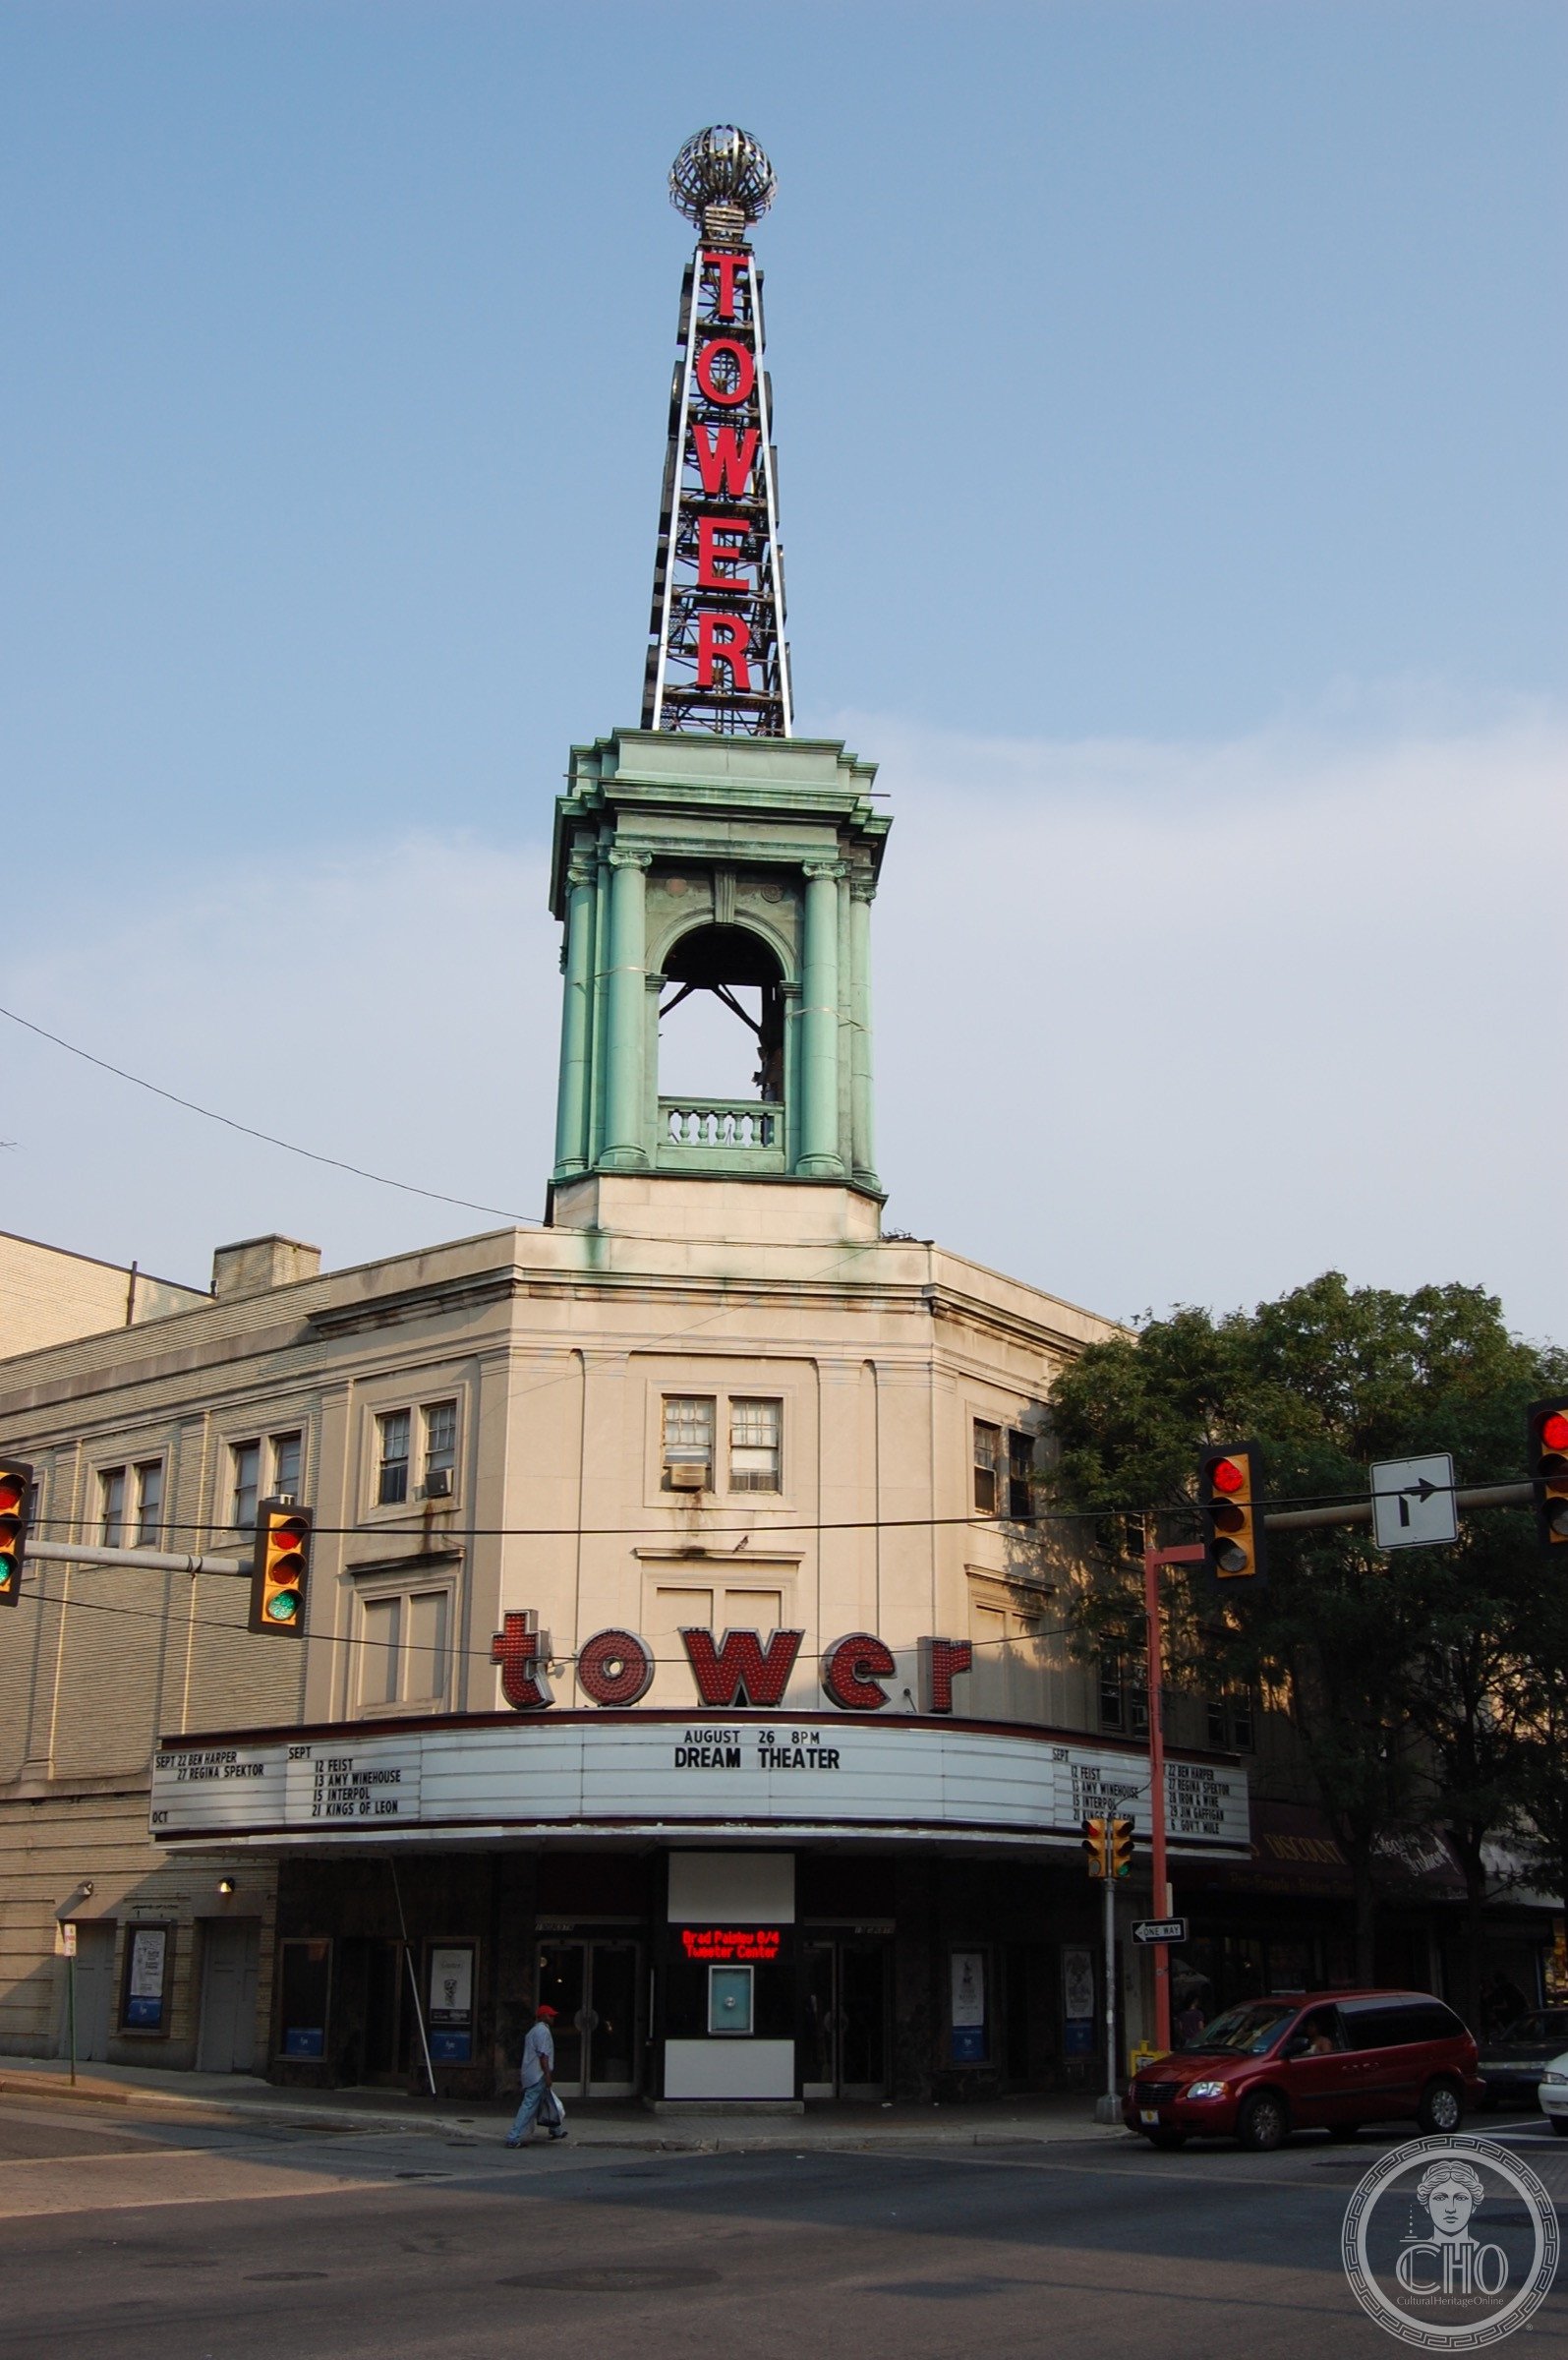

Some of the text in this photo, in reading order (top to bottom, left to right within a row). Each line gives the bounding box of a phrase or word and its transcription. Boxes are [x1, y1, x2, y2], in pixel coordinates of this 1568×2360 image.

[692, 251, 759, 693] TOWER
[684, 1730, 820, 1744] AUGUST 26 8PM
[155, 1750, 237, 1768] SEPT 22 BEN HARPER
[288, 1746, 312, 1760] SEPT
[674, 1747, 841, 1769] DREAM THEATER
[1052, 1747, 1069, 1762] SEPT
[177, 1763, 264, 1781] 27 REGINA SPEKTOR
[315, 1758, 353, 1772] 12 FEIST
[1072, 1765, 1100, 1781] 12 FEIST
[1169, 1763, 1214, 1781] 22 BEN HARPER
[315, 1770, 401, 1788] 13 AMY WINEHOUSE
[314, 1787, 371, 1801] 15 INTERPOL
[1082, 1781, 1097, 1795] AMY
[1099, 1783, 1138, 1799] WINEHOUSE
[1178, 1779, 1200, 1792] REGINA
[1203, 1781, 1230, 1796] SPEKTOR
[312, 1800, 398, 1816] 21 KINGS OF LEON
[1179, 1793, 1193, 1805] IRON
[1203, 1795, 1219, 1808] WINE
[152, 1810, 168, 1823] OCT
[1181, 1805, 1191, 1818] JIM
[1193, 1807, 1224, 1821] GAFFIGAN
[1262, 1833, 1348, 1865] DISCOUNT
[1143, 1926, 1180, 1936] ONE WAY
